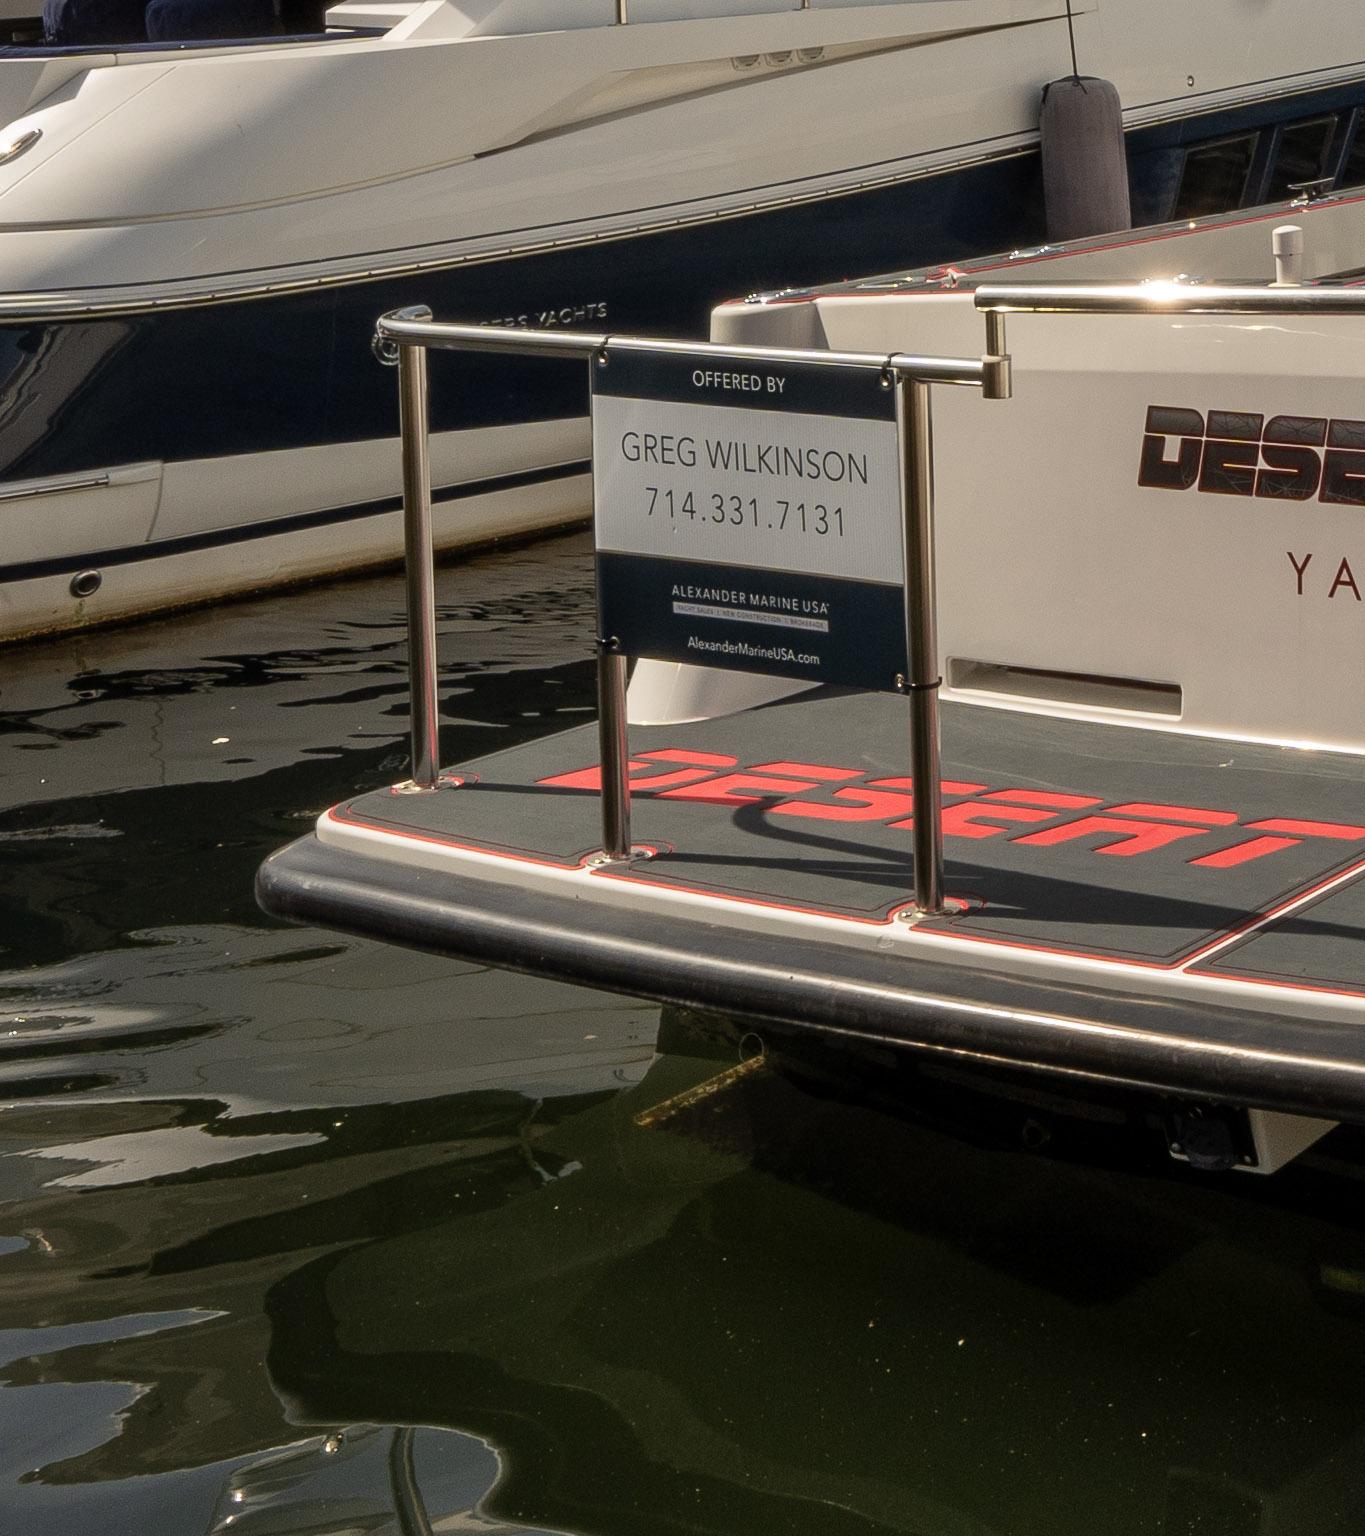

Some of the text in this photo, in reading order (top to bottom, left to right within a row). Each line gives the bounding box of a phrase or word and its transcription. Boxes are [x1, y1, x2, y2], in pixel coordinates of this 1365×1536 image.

[535, 301, 608, 327] YACHTS
[692, 370, 786, 394] OFFERED BY
[621, 431, 868, 485] GREG WILKINSON
[645, 486, 845, 537] 714.331.7131
[671, 584, 747, 605] ALEXANDER
[749, 593, 800, 612] MARINE
[687, 635, 821, 665] AlexanderMarineUSA.com
